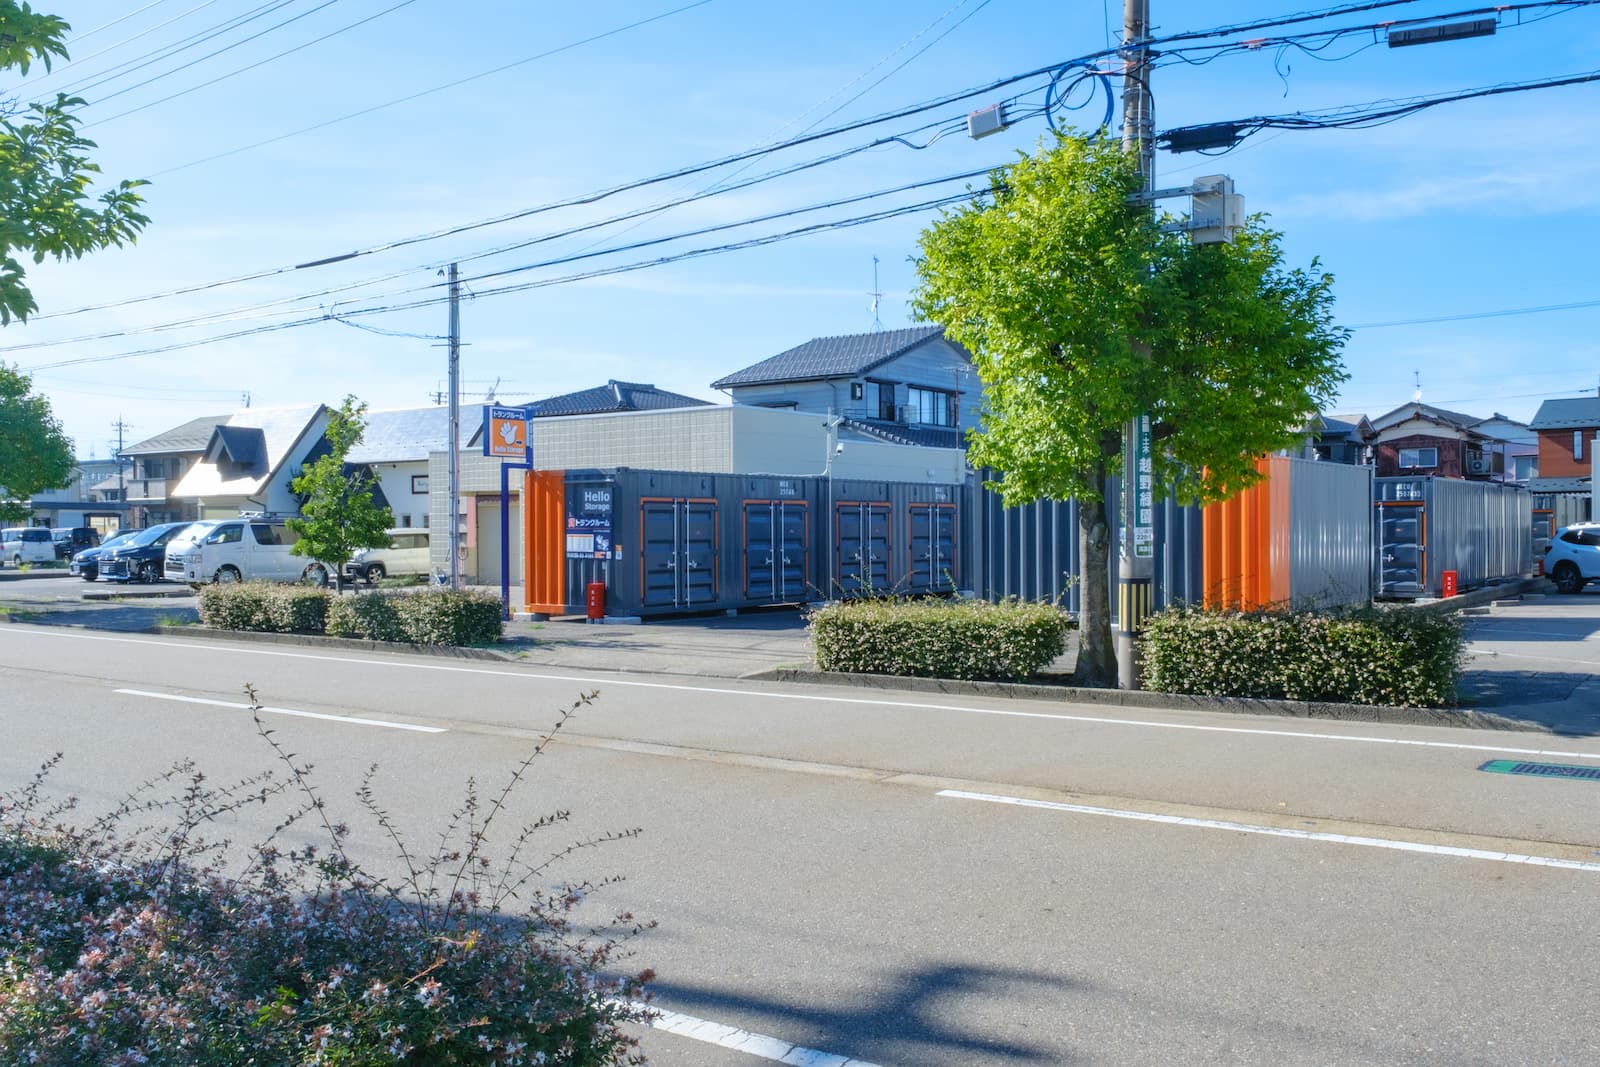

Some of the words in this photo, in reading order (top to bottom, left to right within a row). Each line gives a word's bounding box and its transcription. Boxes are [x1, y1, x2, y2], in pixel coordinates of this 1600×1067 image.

[494, 411, 524, 419] トランクルーム
[584, 491, 610, 502] Hello
[584, 503, 610, 512] Storage
[575, 519, 610, 527] トランクルーム
